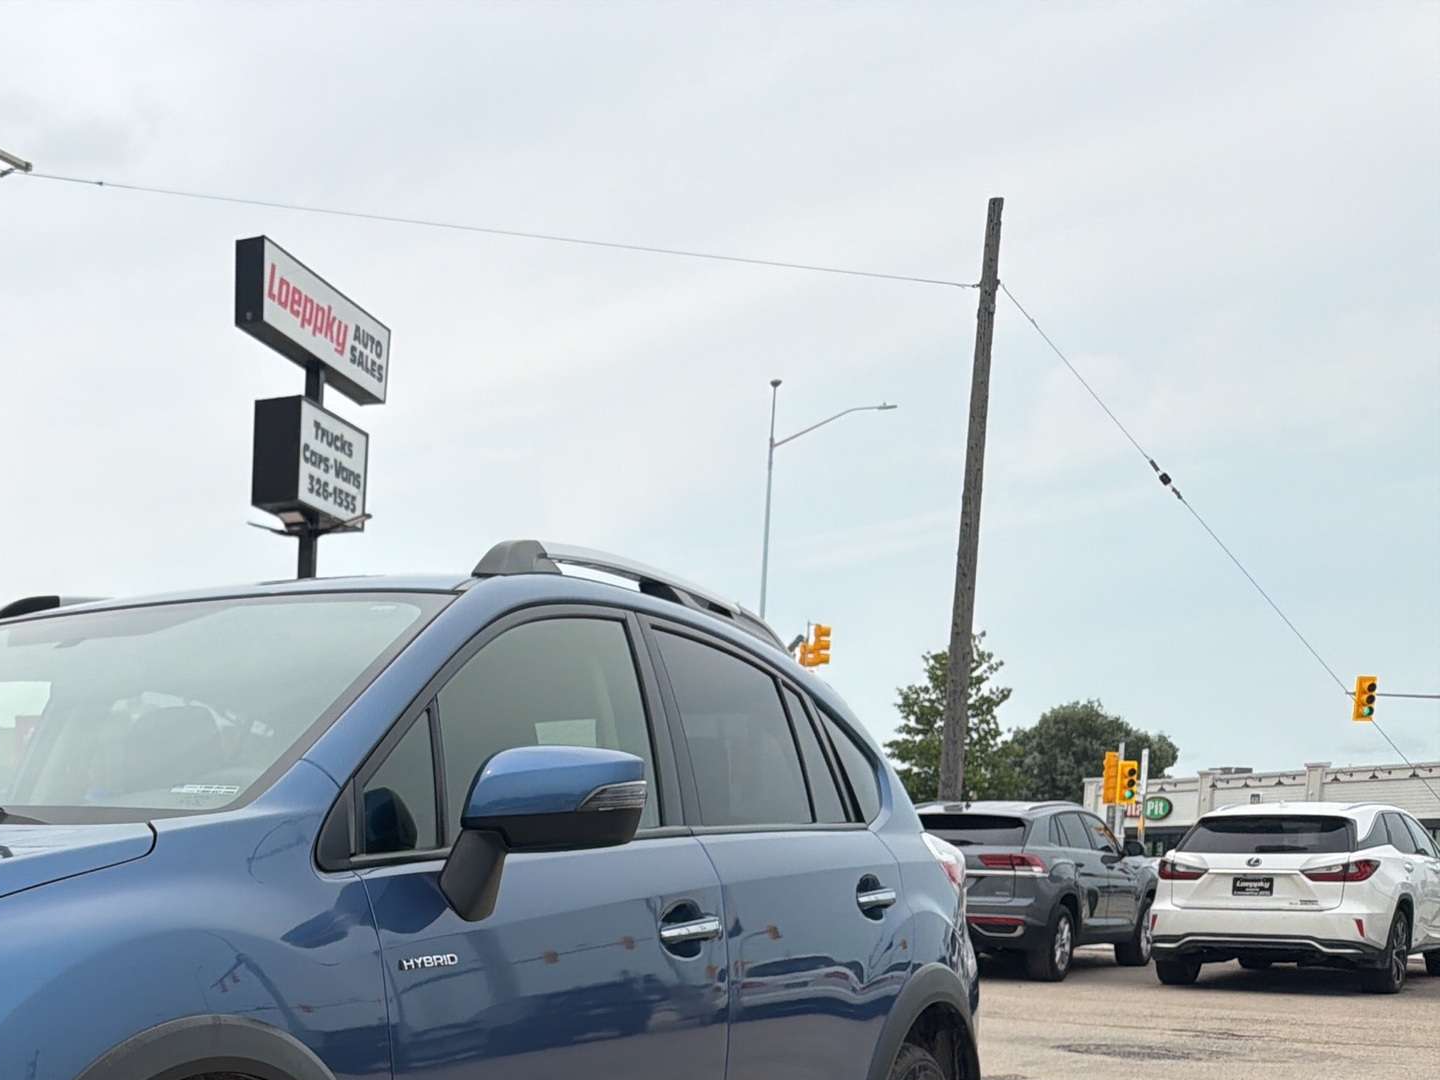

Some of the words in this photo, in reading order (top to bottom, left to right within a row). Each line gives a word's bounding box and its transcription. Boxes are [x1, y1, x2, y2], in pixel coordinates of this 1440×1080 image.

[267, 262, 348, 356] Loeppky
[353, 324, 383, 360] AUTO
[349, 345, 383, 383] SALES
[313, 420, 353, 458] Trucks
[307, 473, 357, 514] 326-1555
[402, 953, 458, 971] HYBRID
